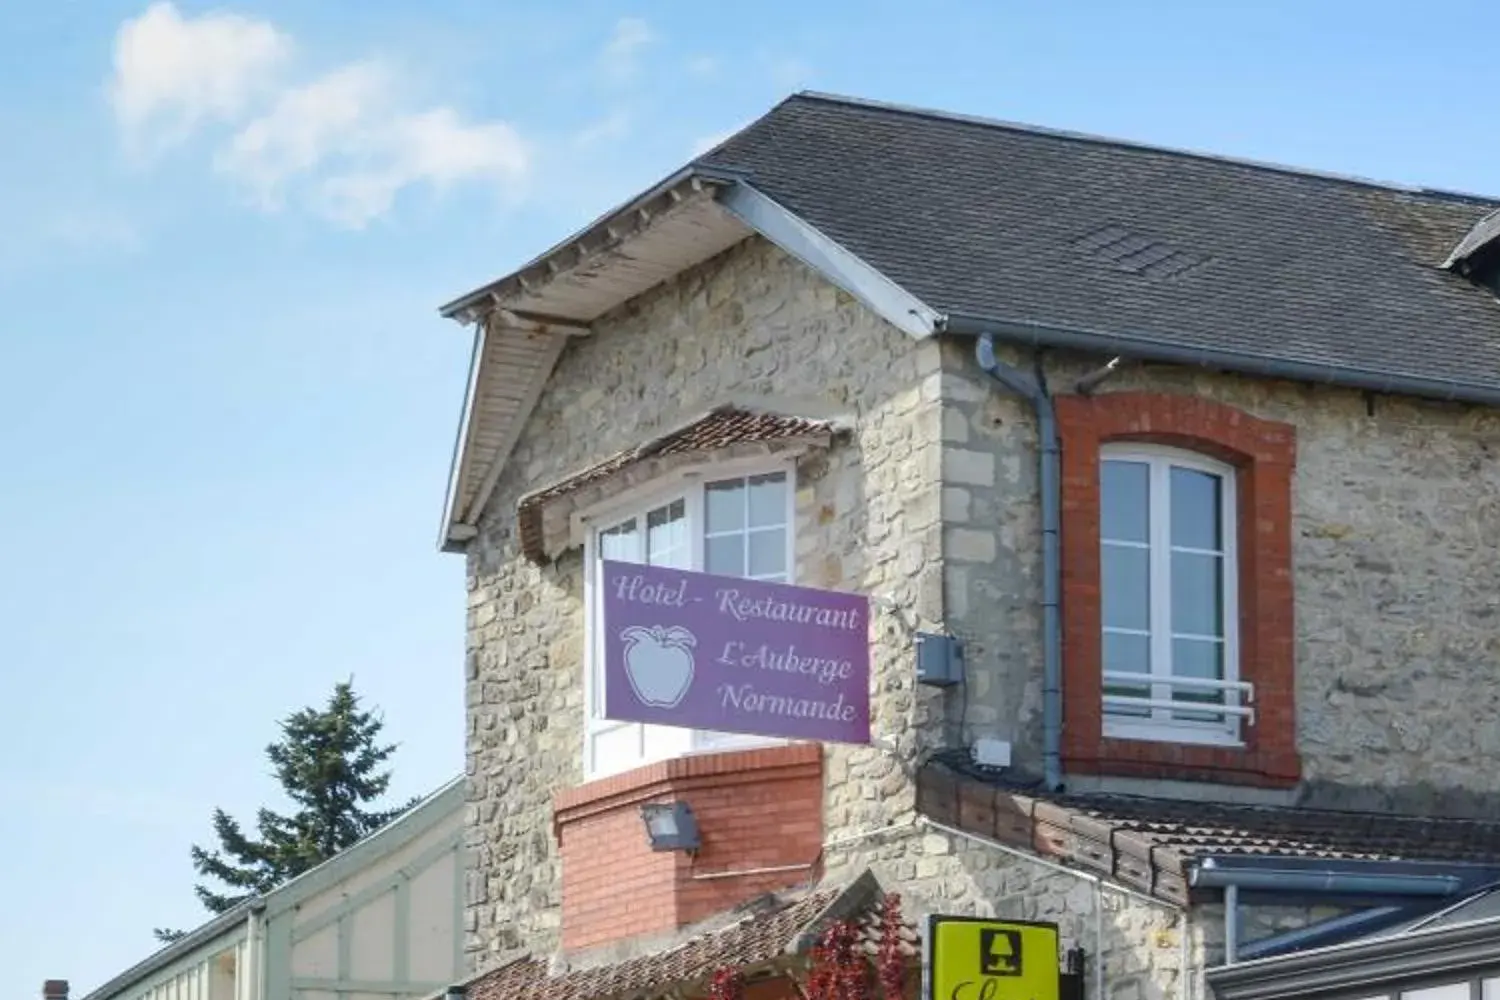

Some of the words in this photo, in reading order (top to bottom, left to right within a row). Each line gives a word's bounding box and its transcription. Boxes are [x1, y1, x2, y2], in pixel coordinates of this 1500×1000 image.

[612, 574, 687, 608] Hotel
[715, 588, 861, 630] Restaurant
[717, 641, 853, 685] L'Auberge
[716, 684, 857, 722] Normande
